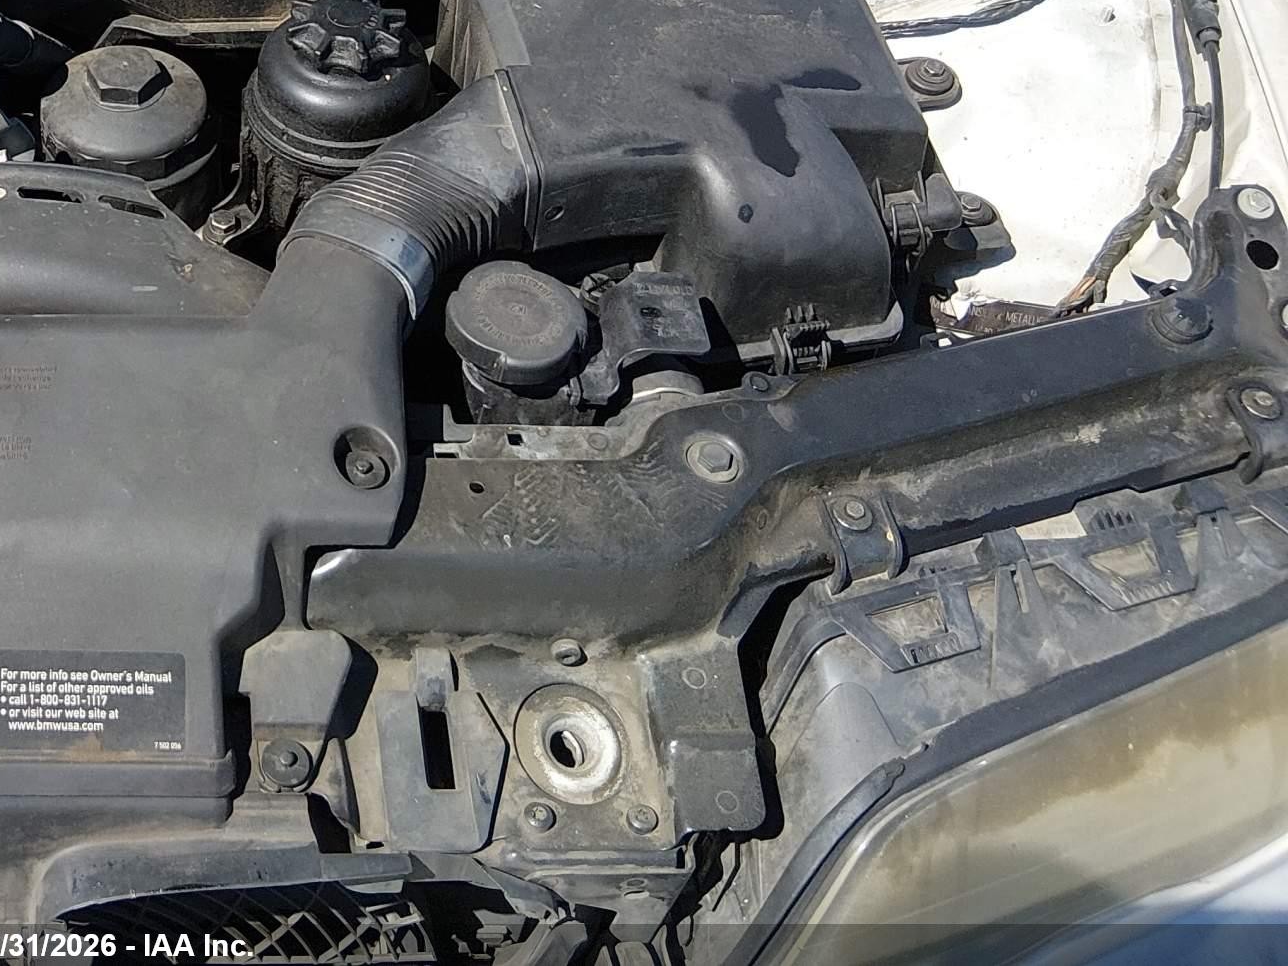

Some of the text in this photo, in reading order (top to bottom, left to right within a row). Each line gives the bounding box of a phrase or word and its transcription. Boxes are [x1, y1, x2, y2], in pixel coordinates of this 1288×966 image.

[0, 668, 172, 683] For more info see Owner's Manual
[0, 681, 154, 695] For a list of other approved oils
[9, 694, 108, 707] call 1-800-831-1117
[9, 707, 119, 720] or visit our web site at
[9, 720, 104, 732] www.bmwusa.com
